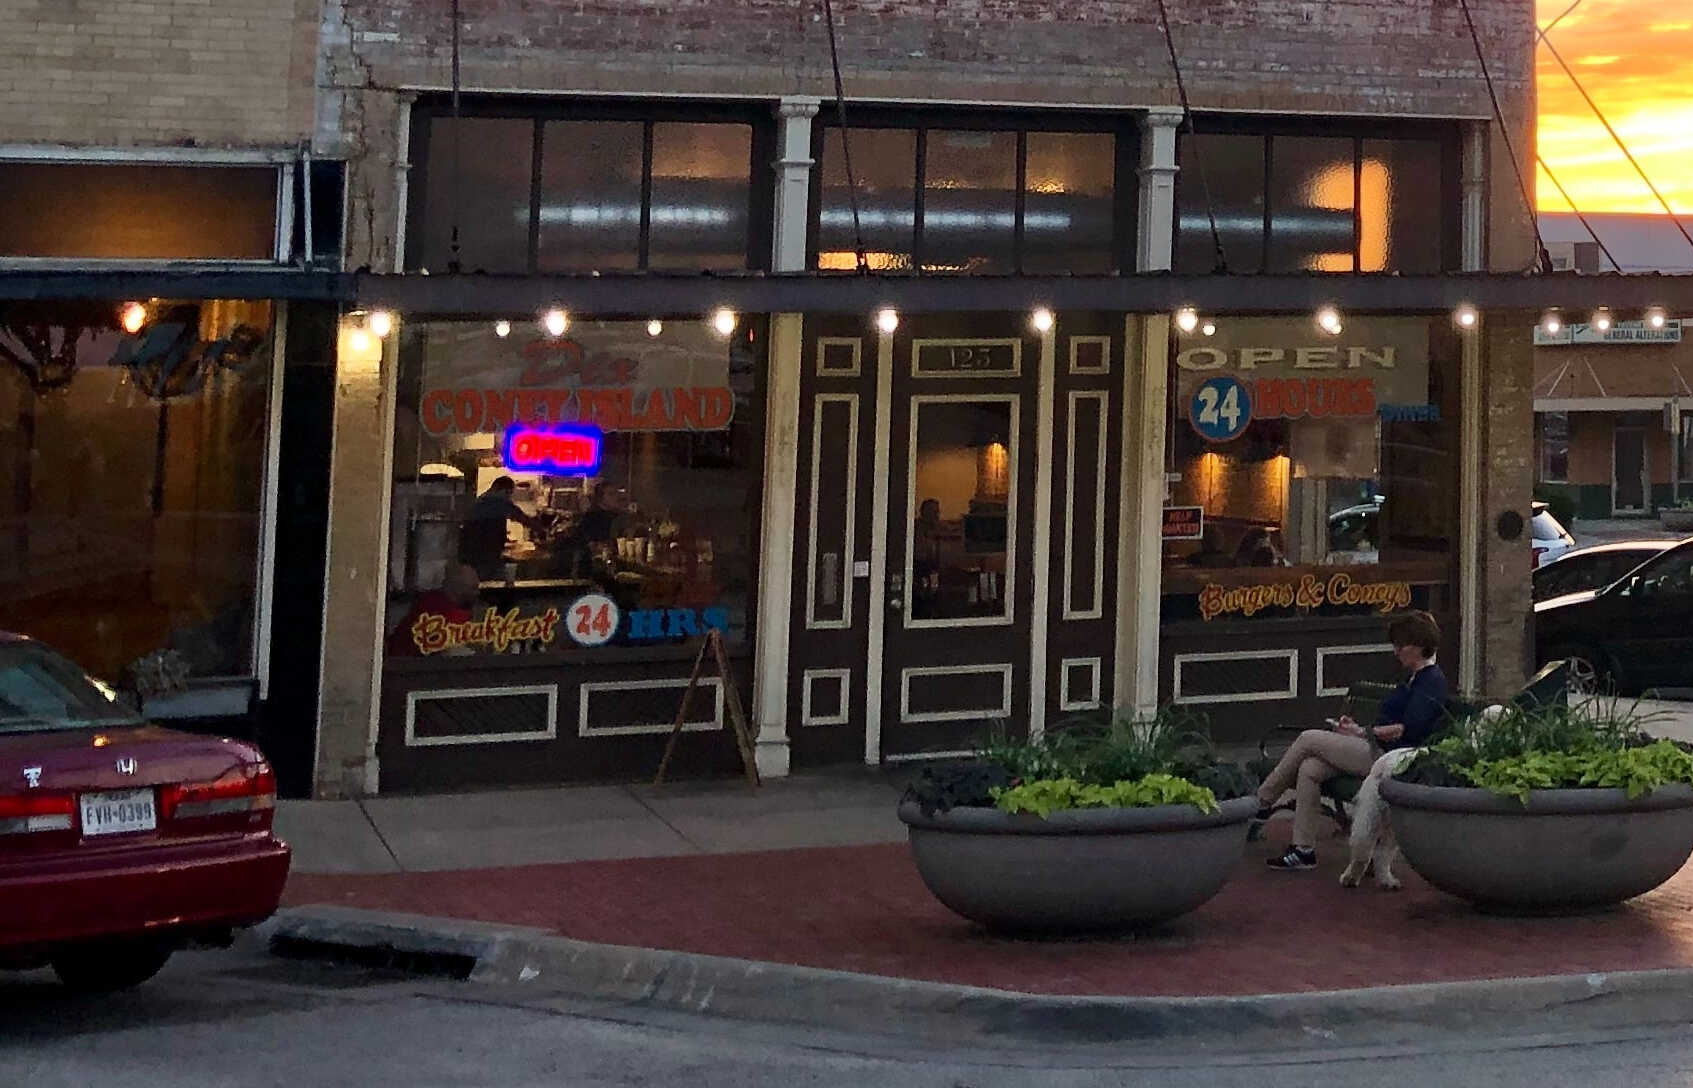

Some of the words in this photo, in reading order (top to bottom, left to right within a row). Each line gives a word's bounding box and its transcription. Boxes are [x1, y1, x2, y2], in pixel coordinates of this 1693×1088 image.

[1176, 345, 1398, 371] OPEN
[420, 387, 577, 433] CONEY
[577, 385, 735, 431] ISLAND
[1198, 384, 1242, 433] 24
[1255, 375, 1377, 417] HOURS
[511, 433, 597, 466] OPEN
[1199, 582, 1295, 621] Burgers
[1295, 573, 1326, 608] &
[1326, 572, 1412, 613] Coneys
[411, 603, 561, 655] Breakfast
[574, 602, 614, 637] 24
[627, 607, 729, 639] HRS
